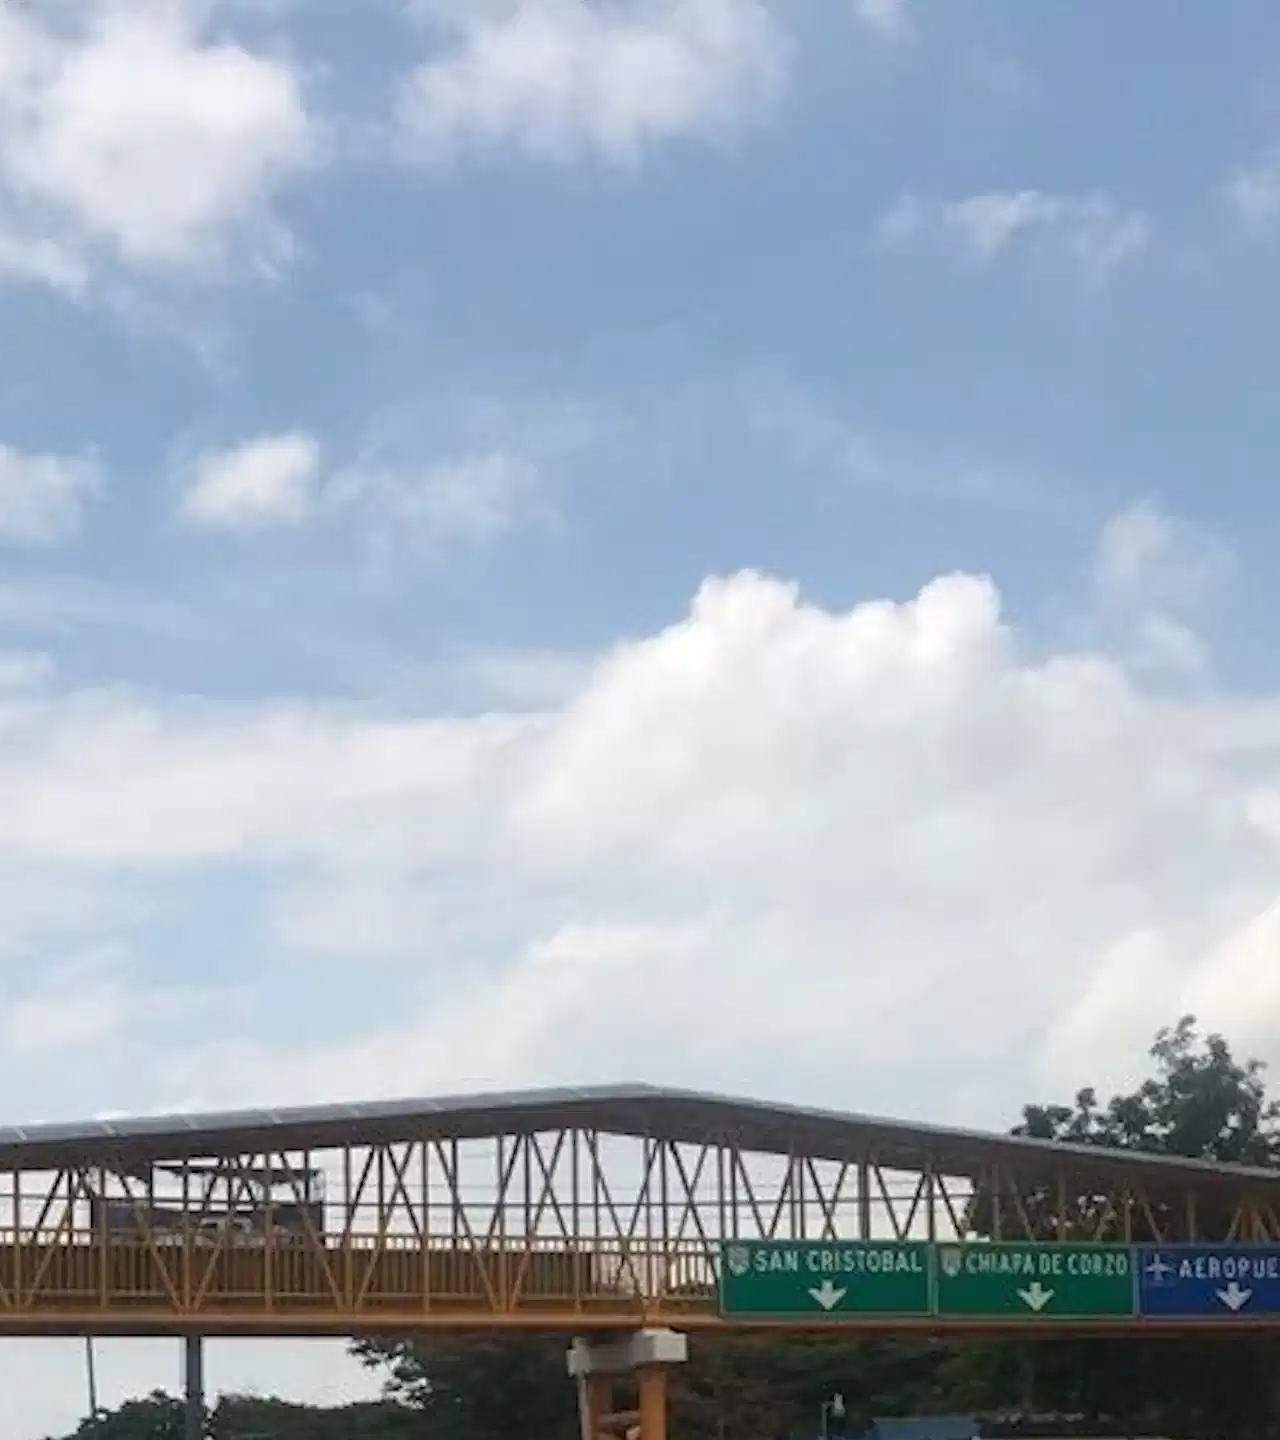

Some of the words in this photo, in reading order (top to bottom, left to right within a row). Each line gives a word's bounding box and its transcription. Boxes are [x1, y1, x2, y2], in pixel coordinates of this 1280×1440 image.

[755, 1250, 798, 1272] SAN
[805, 1250, 923, 1273] CRISTOBAL
[965, 1252, 1035, 1275] CHIAPA
[1038, 1253, 1063, 1275] DE
[1067, 1253, 1128, 1276] CORZO
